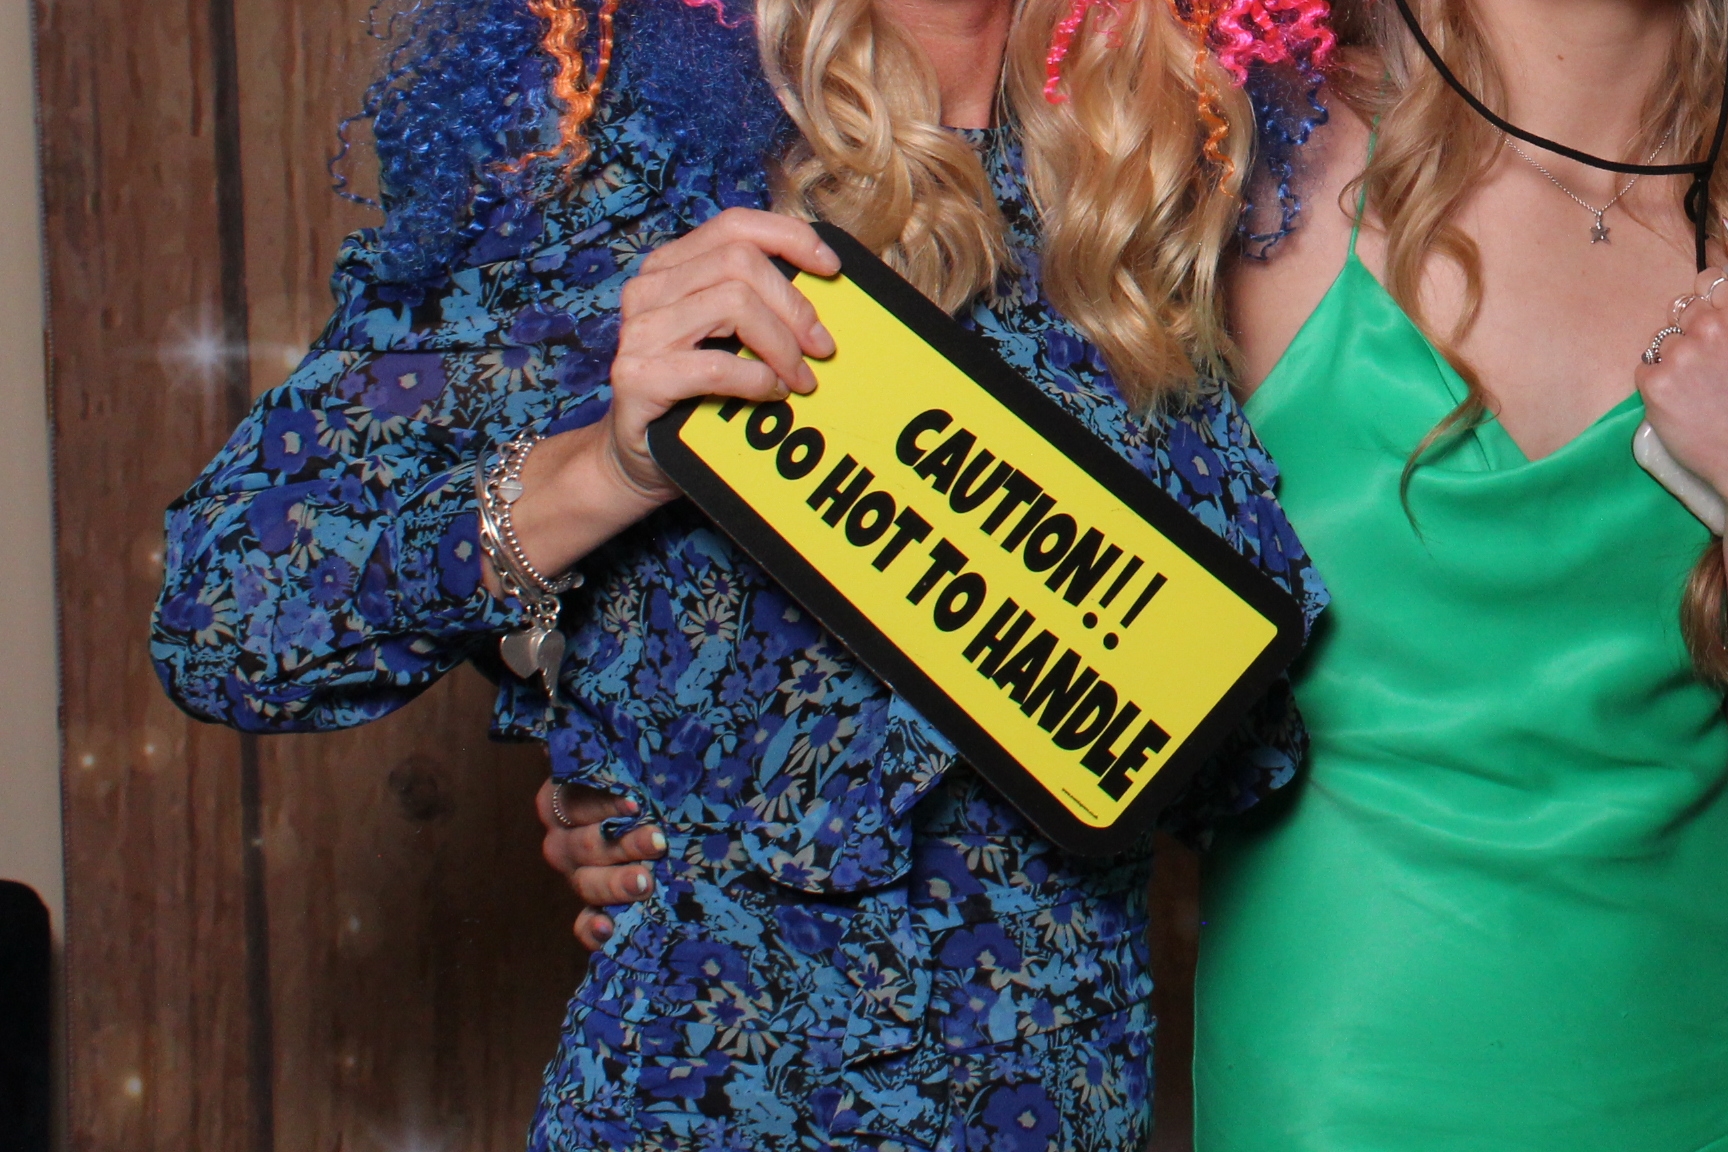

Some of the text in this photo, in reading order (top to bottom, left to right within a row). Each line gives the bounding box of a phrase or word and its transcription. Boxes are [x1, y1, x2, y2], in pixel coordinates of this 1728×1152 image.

[805, 453, 934, 573] HOT
[905, 537, 988, 633] TO
[961, 597, 1172, 803] HANDLE
[895, 408, 1168, 651] CAUTION!!
